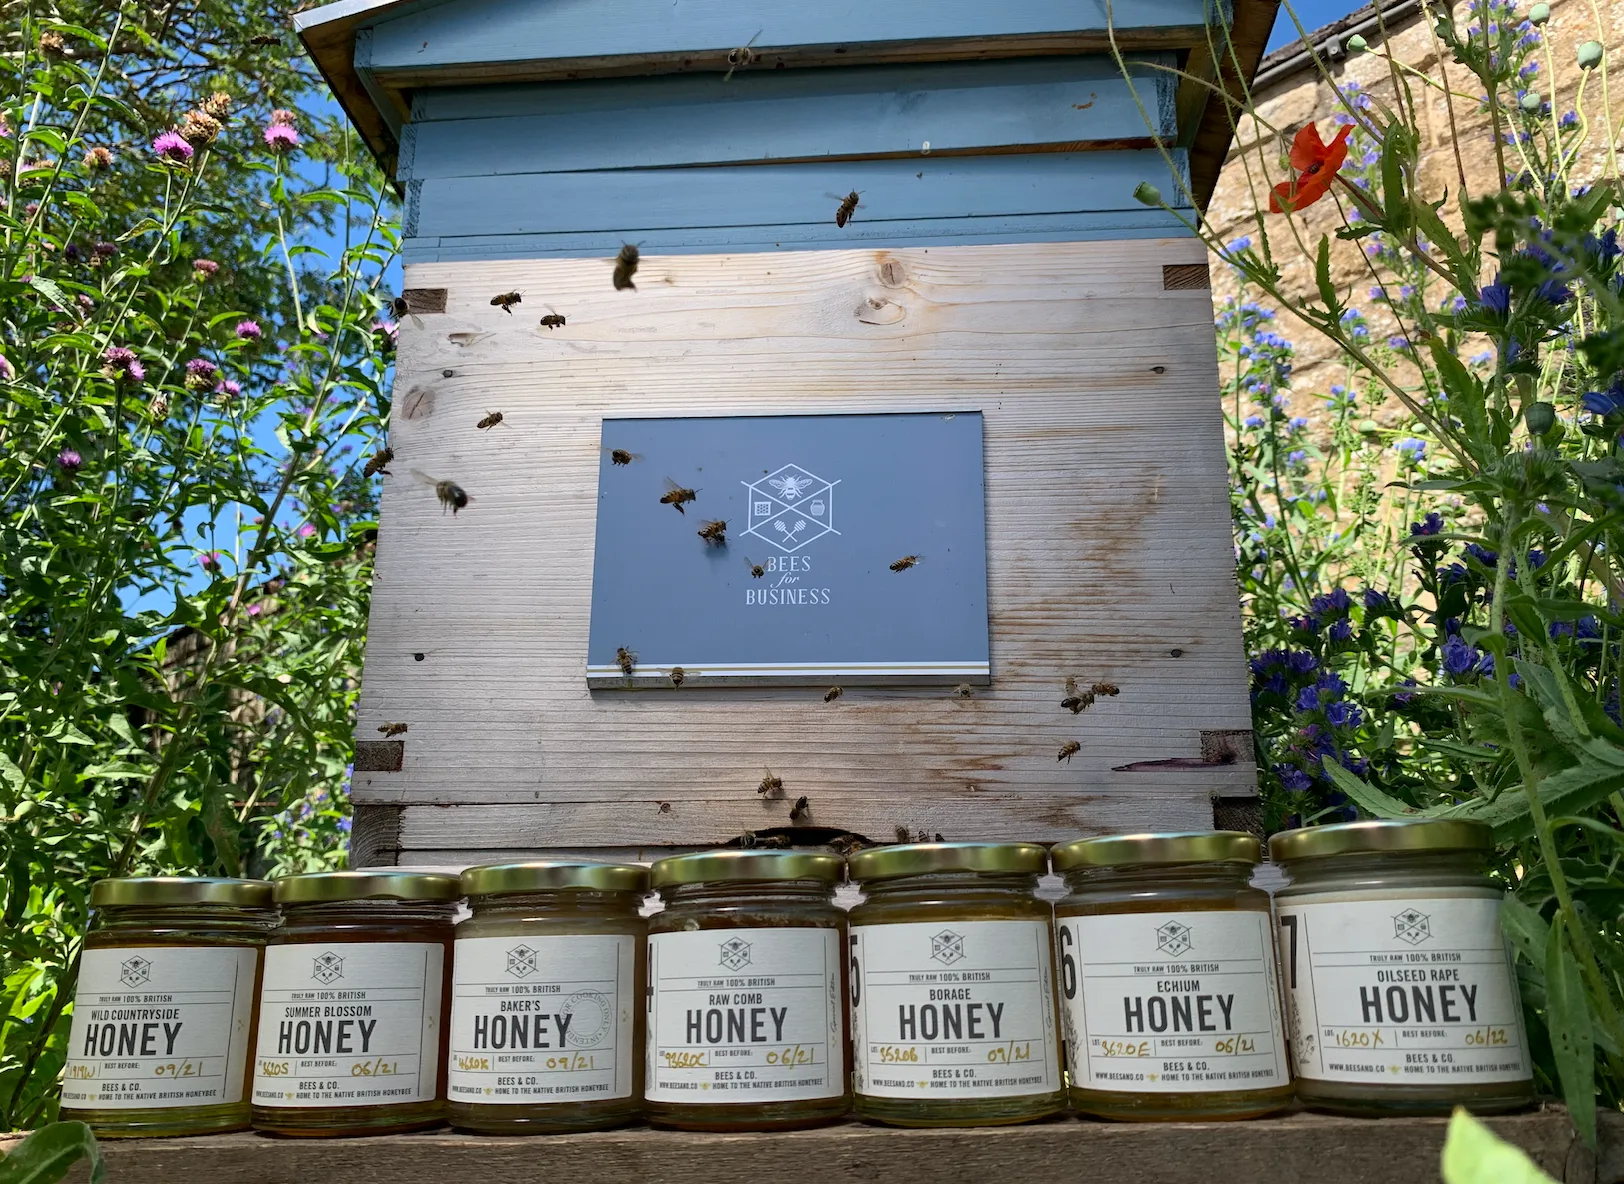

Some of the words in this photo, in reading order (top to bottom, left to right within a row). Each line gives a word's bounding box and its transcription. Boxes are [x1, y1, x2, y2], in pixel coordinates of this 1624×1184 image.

[768, 556, 811, 572] BEES
[770, 572, 800, 588] for
[746, 588, 830, 605] BUSINESS
[1281, 915, 1297, 989] 7
[1406, 954, 1428, 962] 100%
[1431, 953, 1461, 961] BRITISH
[1059, 925, 1076, 1000] 6
[1167, 965, 1188, 973] 100%
[1191, 964, 1219, 972] BRITISH
[748, 978, 775, 986] BRITISH
[962, 972, 990, 980] BRITISH
[1377, 970, 1426, 983] OILSEED
[1431, 969, 1459, 981] RAPE
[533, 985, 560, 993] BRITISH
[1157, 980, 1200, 993] ECHIUM
[709, 994, 729, 1005] RAW
[734, 993, 762, 1004] COMB
[930, 988, 971, 1000] BORAGE
[501, 1001, 540, 1012] BAKER'S
[1360, 984, 1477, 1023] HONEY
[92, 1010, 109, 1021] WILD
[112, 1009, 180, 1020] COUNTRYSIDE
[285, 1007, 320, 1018] SUMMER
[324, 1006, 372, 1017] BLOSSOM
[1123, 994, 1234, 1033] HONEY
[686, 1007, 787, 1043] HONEY
[899, 1002, 1004, 1040] HONEY
[278, 1020, 377, 1054] HONEY
[474, 1014, 573, 1049] HONEY
[1403, 1030, 1418, 1038] BEST
[1420, 1030, 1447, 1038] BEFORE:
[1465, 1026, 1508, 1046] 06/22
[84, 1023, 183, 1056] HONEY
[1161, 1039, 1176, 1047] BEST
[1336, 1029, 1384, 1049] 1620X
[546, 1051, 594, 1071] 09/21
[766, 1044, 814, 1070] 06/21
[1406, 1054, 1428, 1063] BEES
[1432, 1054, 1438, 1063] &
[1441, 1054, 1456, 1063] CO.
[155, 1058, 202, 1079] 09/21
[352, 1058, 397, 1077] 06/21
[1164, 1063, 1184, 1071] BEES
[1187, 1062, 1193, 1071] &
[1196, 1062, 1210, 1070] CO.
[1329, 1064, 1385, 1073] WWW.BEESAND.CO
[1404, 1065, 1424, 1073] HOME
[1426, 1065, 1435, 1073] TO
[1437, 1065, 1449, 1073] THE
[1452, 1064, 1474, 1072] NATIVE
[1476, 1064, 1498, 1072] BRITISH
[715, 1071, 734, 1080] BEES
[737, 1071, 742, 1080] &
[745, 1071, 757, 1080] CO.
[932, 1070, 952, 1078] BEES
[956, 1070, 961, 1078] &
[964, 1069, 977, 1078] CO.
[1161, 1073, 1179, 1081] HOME
[1182, 1073, 1190, 1081] TO
[1206, 1072, 1226, 1080] NATIVE
[1228, 1071, 1250, 1079] BRITISH
[102, 1083, 119, 1091] BEES
[129, 1083, 141, 1091] CO.
[299, 1082, 317, 1090] BEES
[498, 1077, 515, 1085] BEES
[518, 1077, 523, 1085] &
[526, 1077, 538, 1085] CO.
[774, 1080, 796, 1088] BRITISH
[930, 1080, 948, 1088] HOME
[973, 1079, 993, 1087] NATIVE
[995, 1078, 1017, 1086] BRITISH
[136, 1092, 156, 1100] NATIVE
[159, 1091, 184, 1099] BRITISH
[186, 1090, 216, 1098] HONEYBEE
[334, 1090, 355, 1098] NATIVE
[382, 1088, 411, 1096] HONEYBEE
